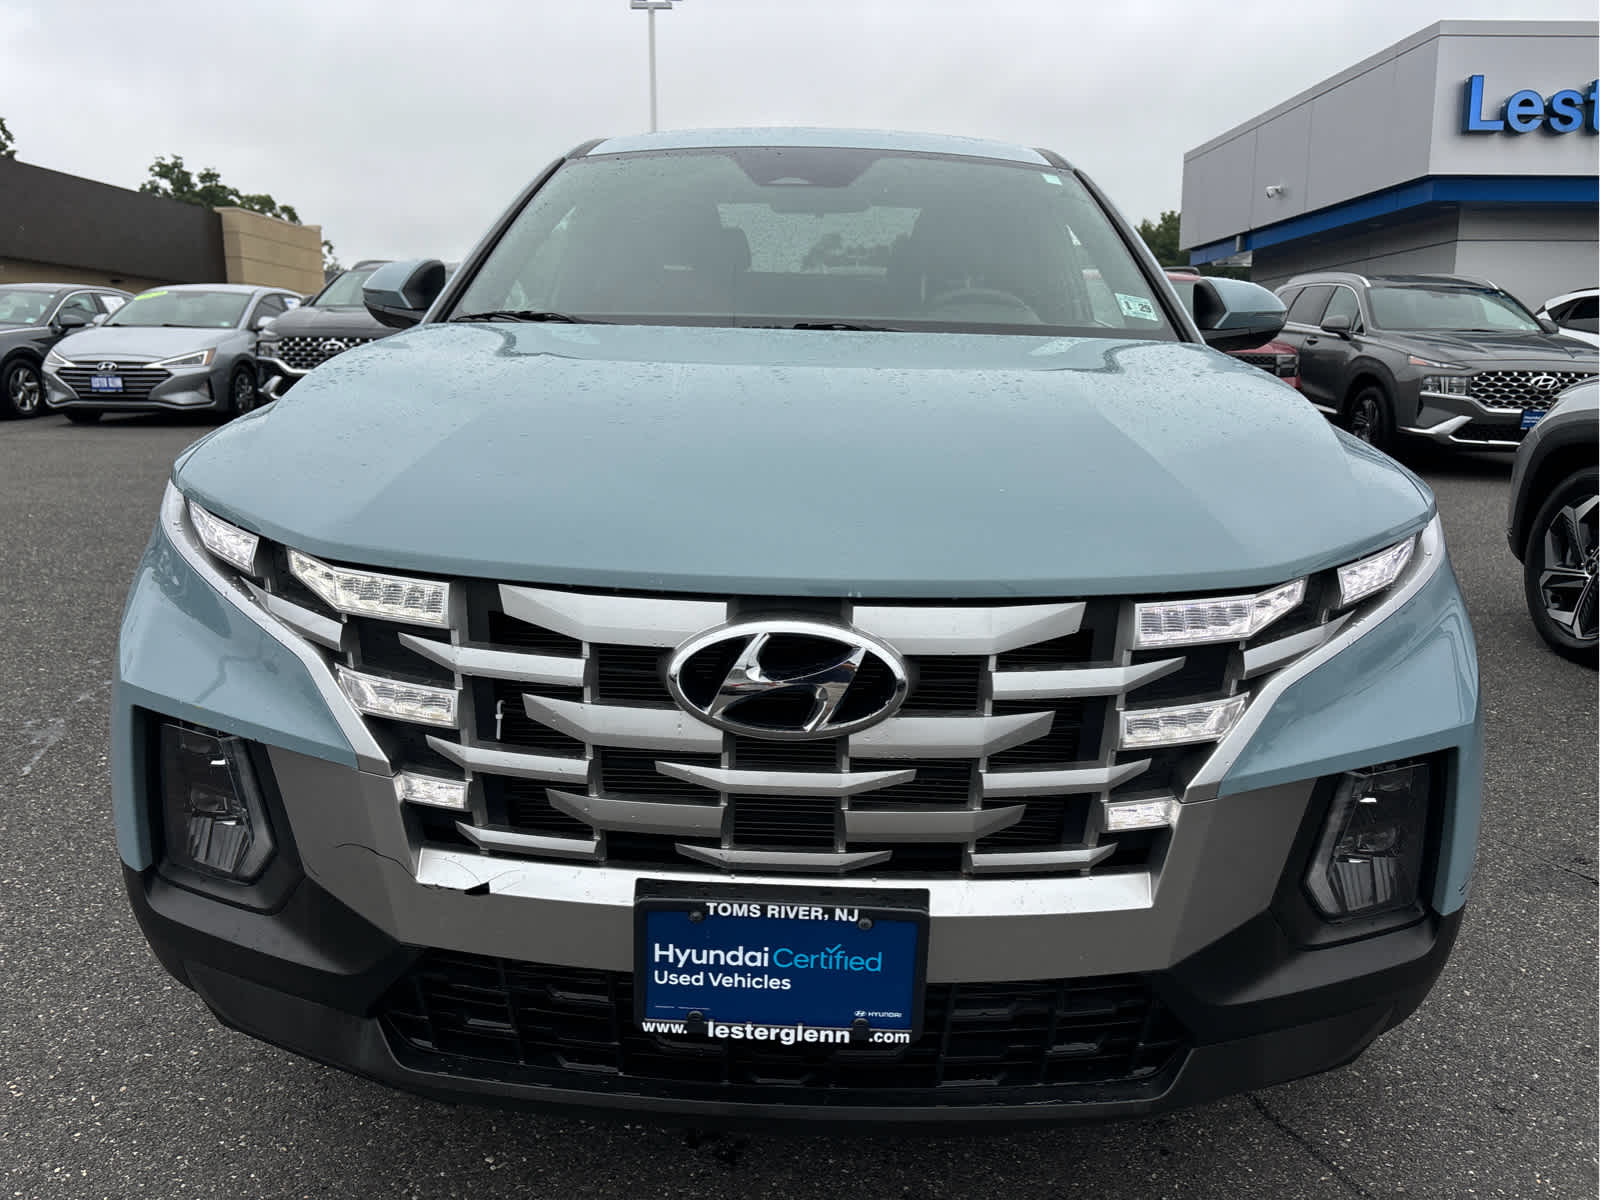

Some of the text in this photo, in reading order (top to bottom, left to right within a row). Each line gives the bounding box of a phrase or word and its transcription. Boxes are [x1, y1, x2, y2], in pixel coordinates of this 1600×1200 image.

[705, 902, 859, 922] TOMS RIVER, NJ
[654, 943, 883, 972] Hyundai Certified
[654, 970, 792, 990] Used Vehicles
[642, 1021, 910, 1045] www. lesterglenn .com
